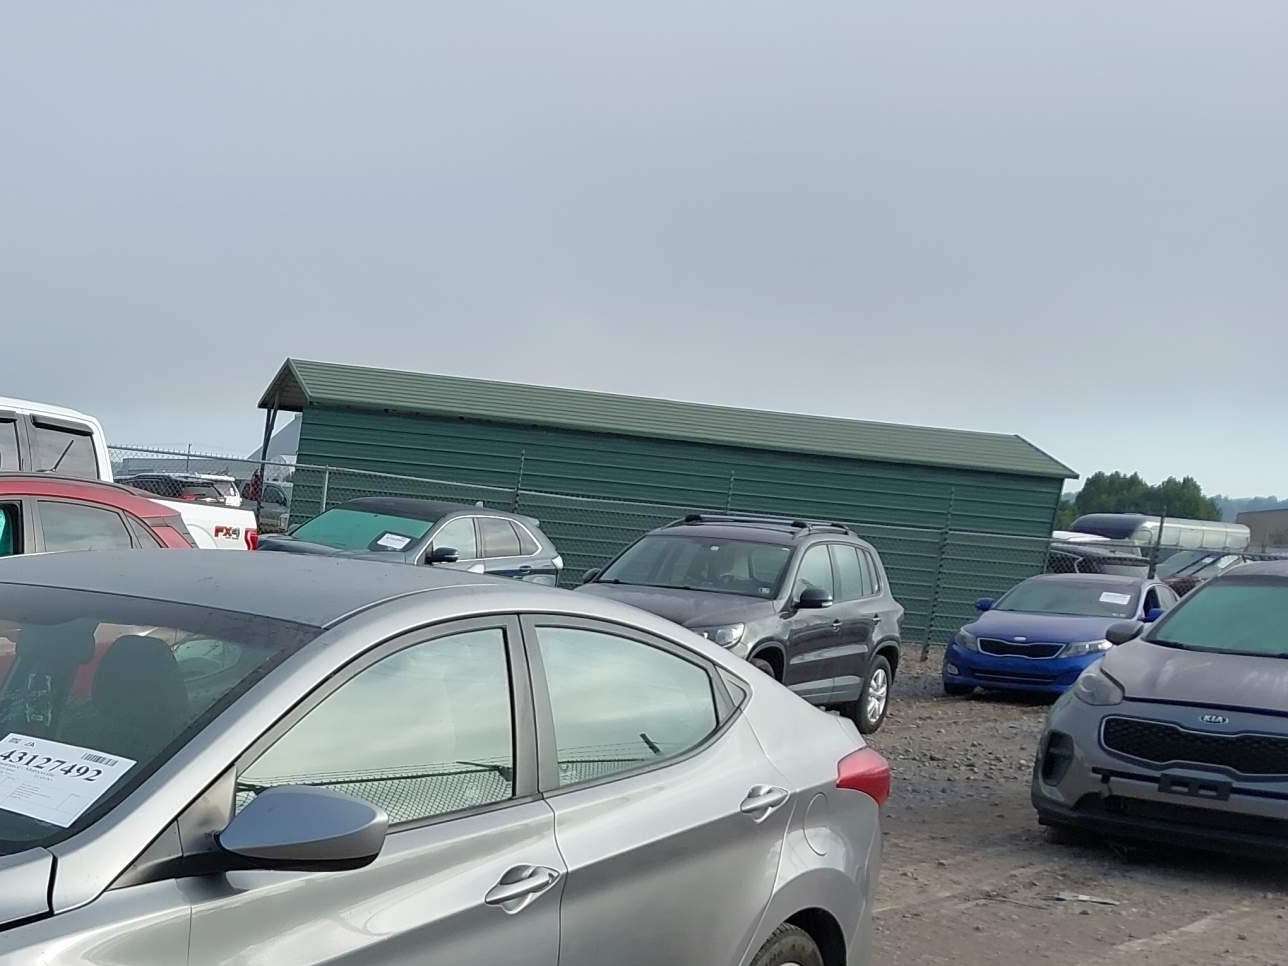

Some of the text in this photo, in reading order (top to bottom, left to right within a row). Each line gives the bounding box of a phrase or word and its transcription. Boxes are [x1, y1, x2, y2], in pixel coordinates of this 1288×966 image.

[214, 526, 240, 538] FX4
[1203, 715, 1224, 723] KIA
[0, 750, 103, 782] 43127492
